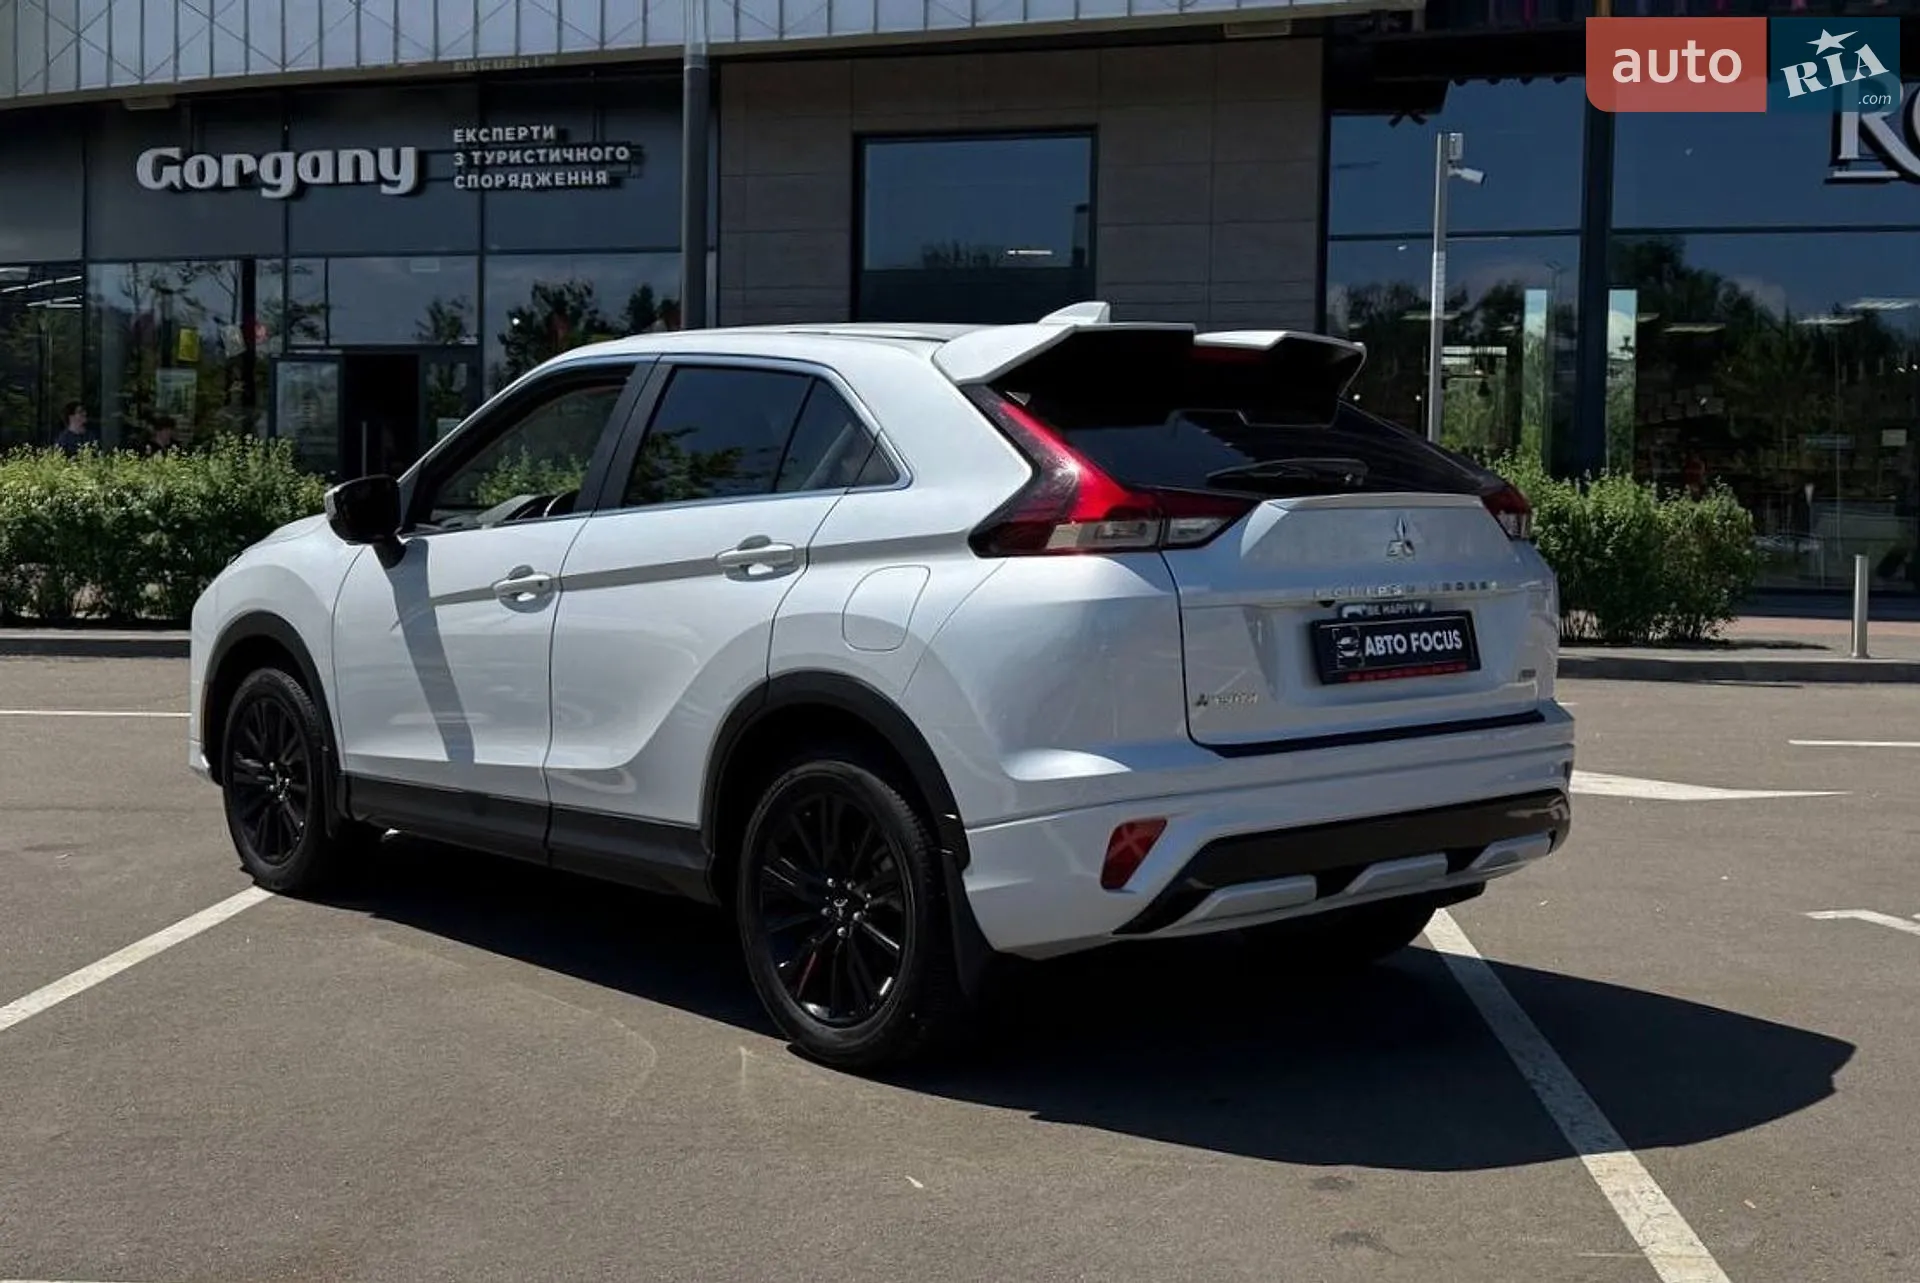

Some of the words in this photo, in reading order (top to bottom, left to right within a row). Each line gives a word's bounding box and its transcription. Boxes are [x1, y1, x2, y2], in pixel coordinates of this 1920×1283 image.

[453, 124, 556, 143] ЕКСПЕРТИ
[453, 153, 466, 166] З
[471, 146, 631, 166] ТУРИСТИЧНОГО
[136, 145, 419, 198] Gorgany
[453, 170, 609, 190] СПОРЯДЖЕННЯ
[1364, 633, 1407, 657] АВТО
[1410, 629, 1463, 654] FOCUS
